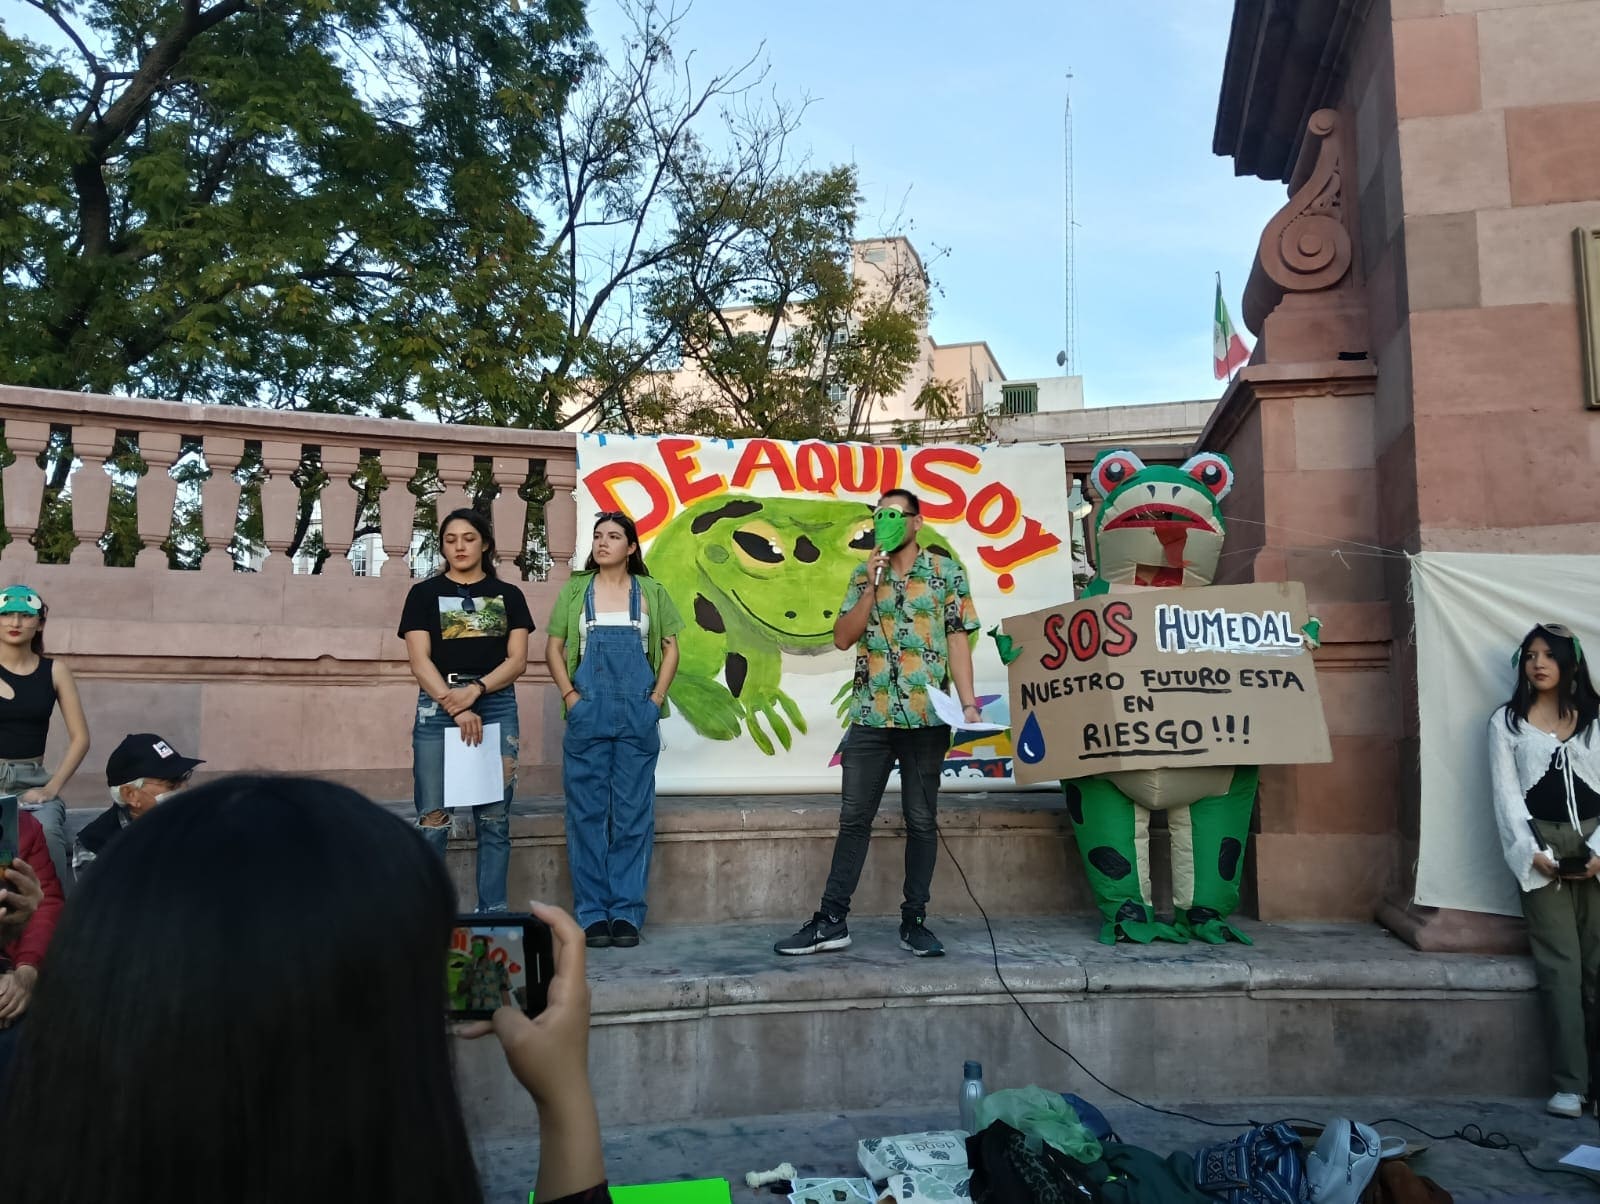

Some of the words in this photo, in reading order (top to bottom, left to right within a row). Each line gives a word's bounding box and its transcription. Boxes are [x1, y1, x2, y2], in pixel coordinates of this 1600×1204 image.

[582, 438, 728, 543] DE
[730, 438, 904, 498] AQUI
[1040, 601, 1137, 670] SOS
[1156, 604, 1304, 652] HUMEDAL
[1020, 671, 1125, 710] NUESTRO
[1140, 667, 1232, 687] FUTURO
[1239, 669, 1305, 692] ESTA
[1123, 695, 1154, 713] EN
